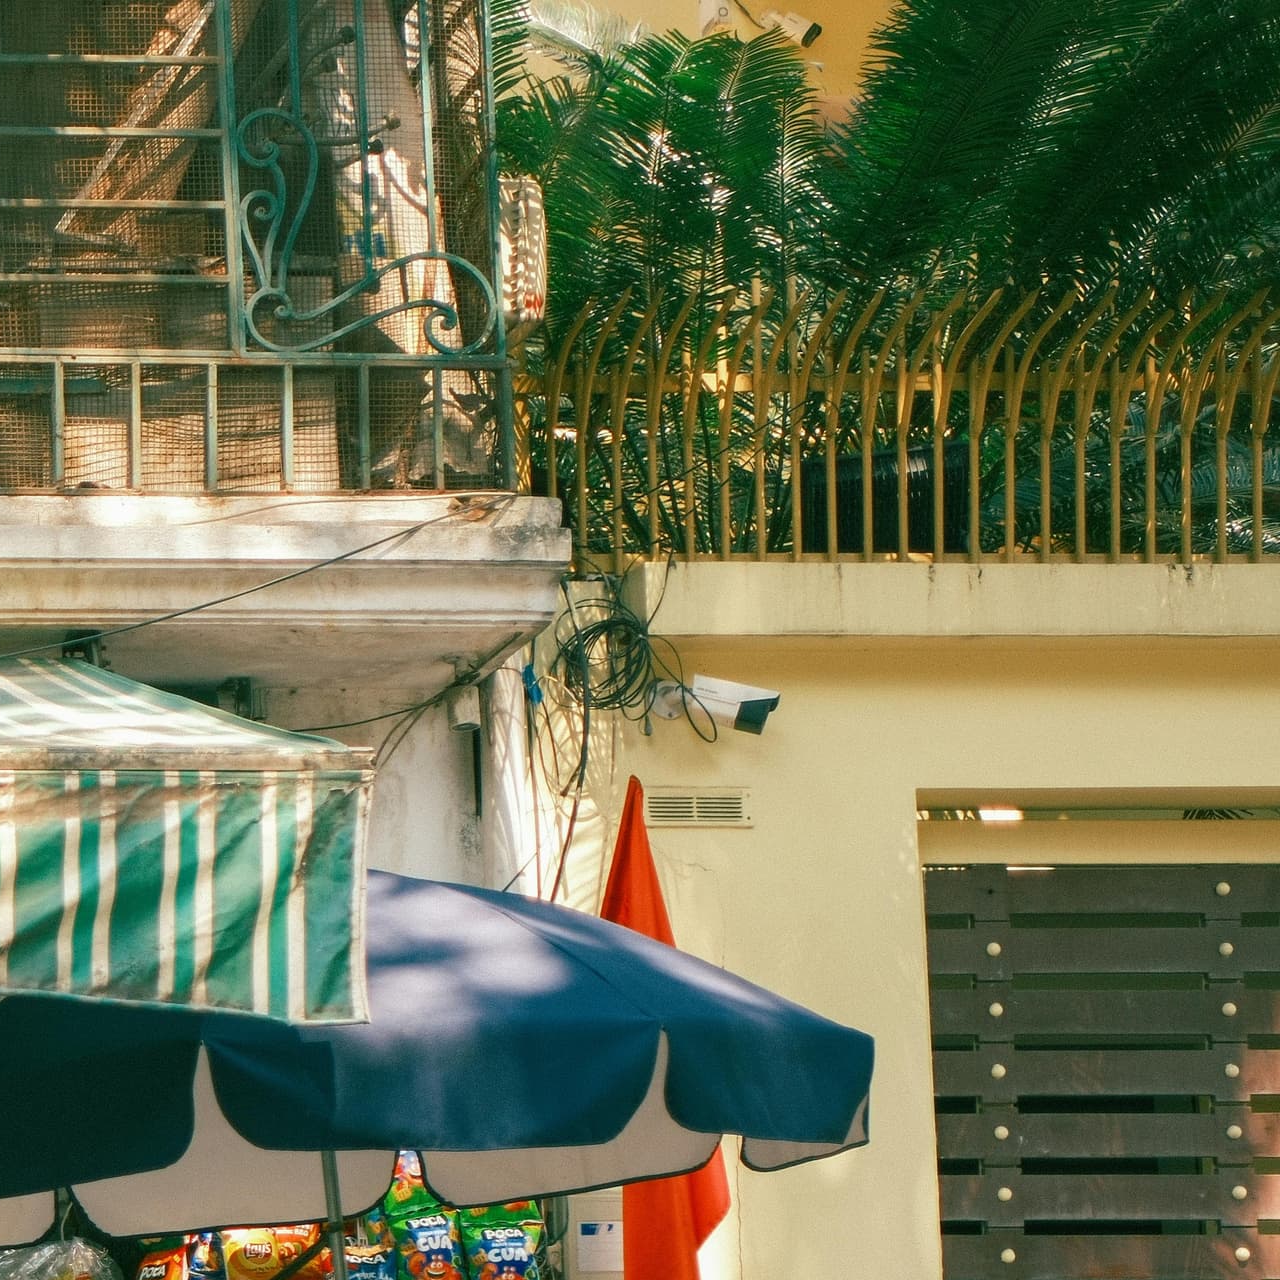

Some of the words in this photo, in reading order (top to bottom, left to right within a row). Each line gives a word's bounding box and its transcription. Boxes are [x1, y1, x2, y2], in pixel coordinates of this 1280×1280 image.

[408, 1215, 446, 1228] POCA
[484, 1228, 524, 1239] POCA
[245, 1243, 272, 1258] Lay's
[416, 1236, 453, 1251] CUA
[488, 1248, 529, 1262] CUA
[140, 1265, 166, 1280] POCA
